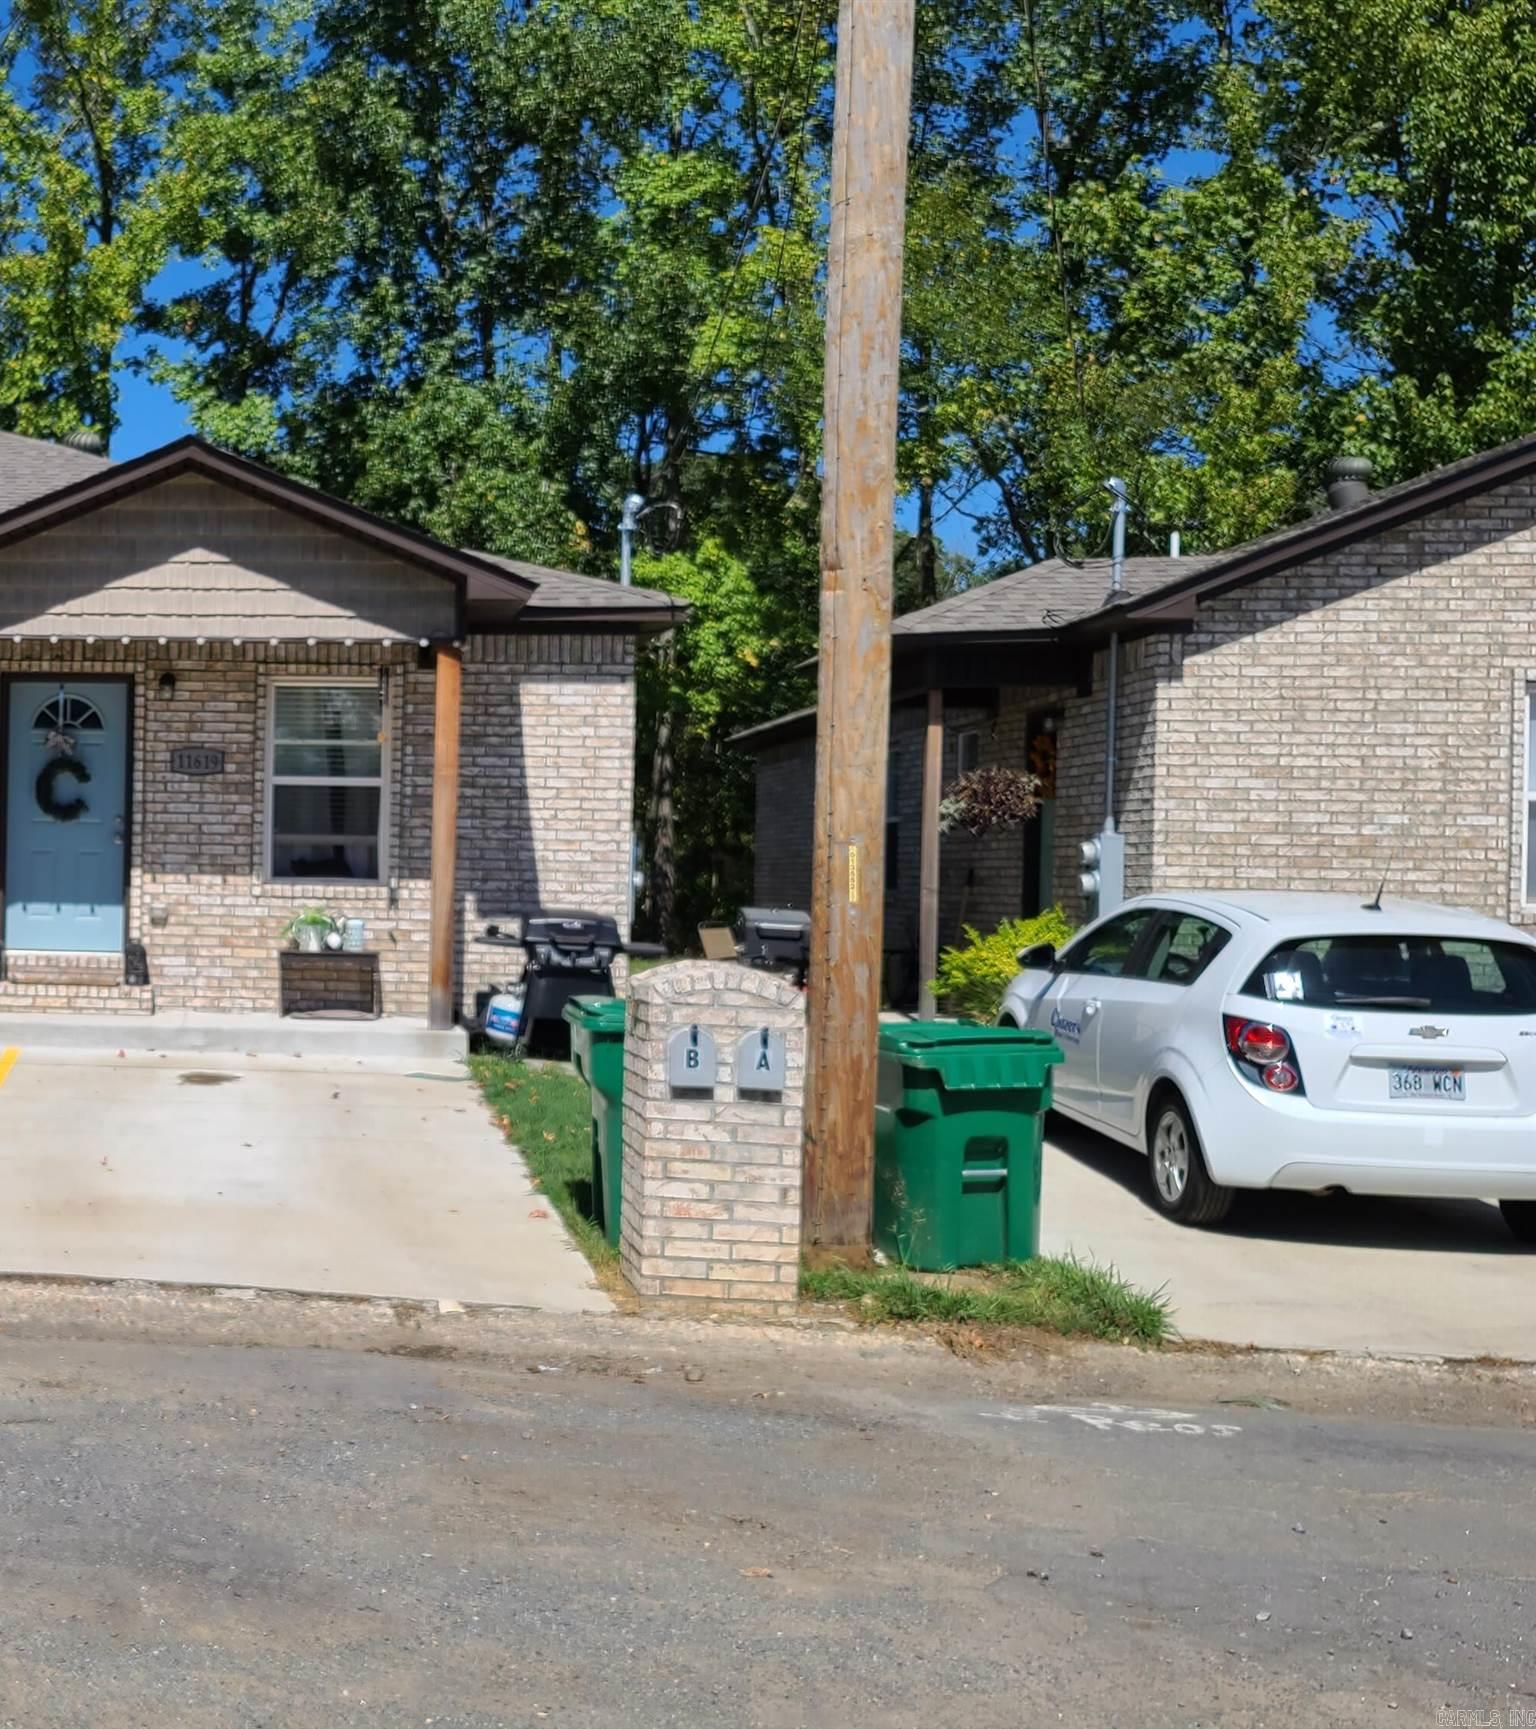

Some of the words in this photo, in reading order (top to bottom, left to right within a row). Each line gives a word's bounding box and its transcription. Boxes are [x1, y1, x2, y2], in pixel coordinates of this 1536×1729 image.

[178, 754, 218, 769] 11619
[35, 758, 91, 821] C
[686, 1048, 700, 1069] B
[755, 1049, 771, 1072] A
[1392, 1073, 1423, 1091] 368
[1432, 1074, 1463, 1094] WCN
